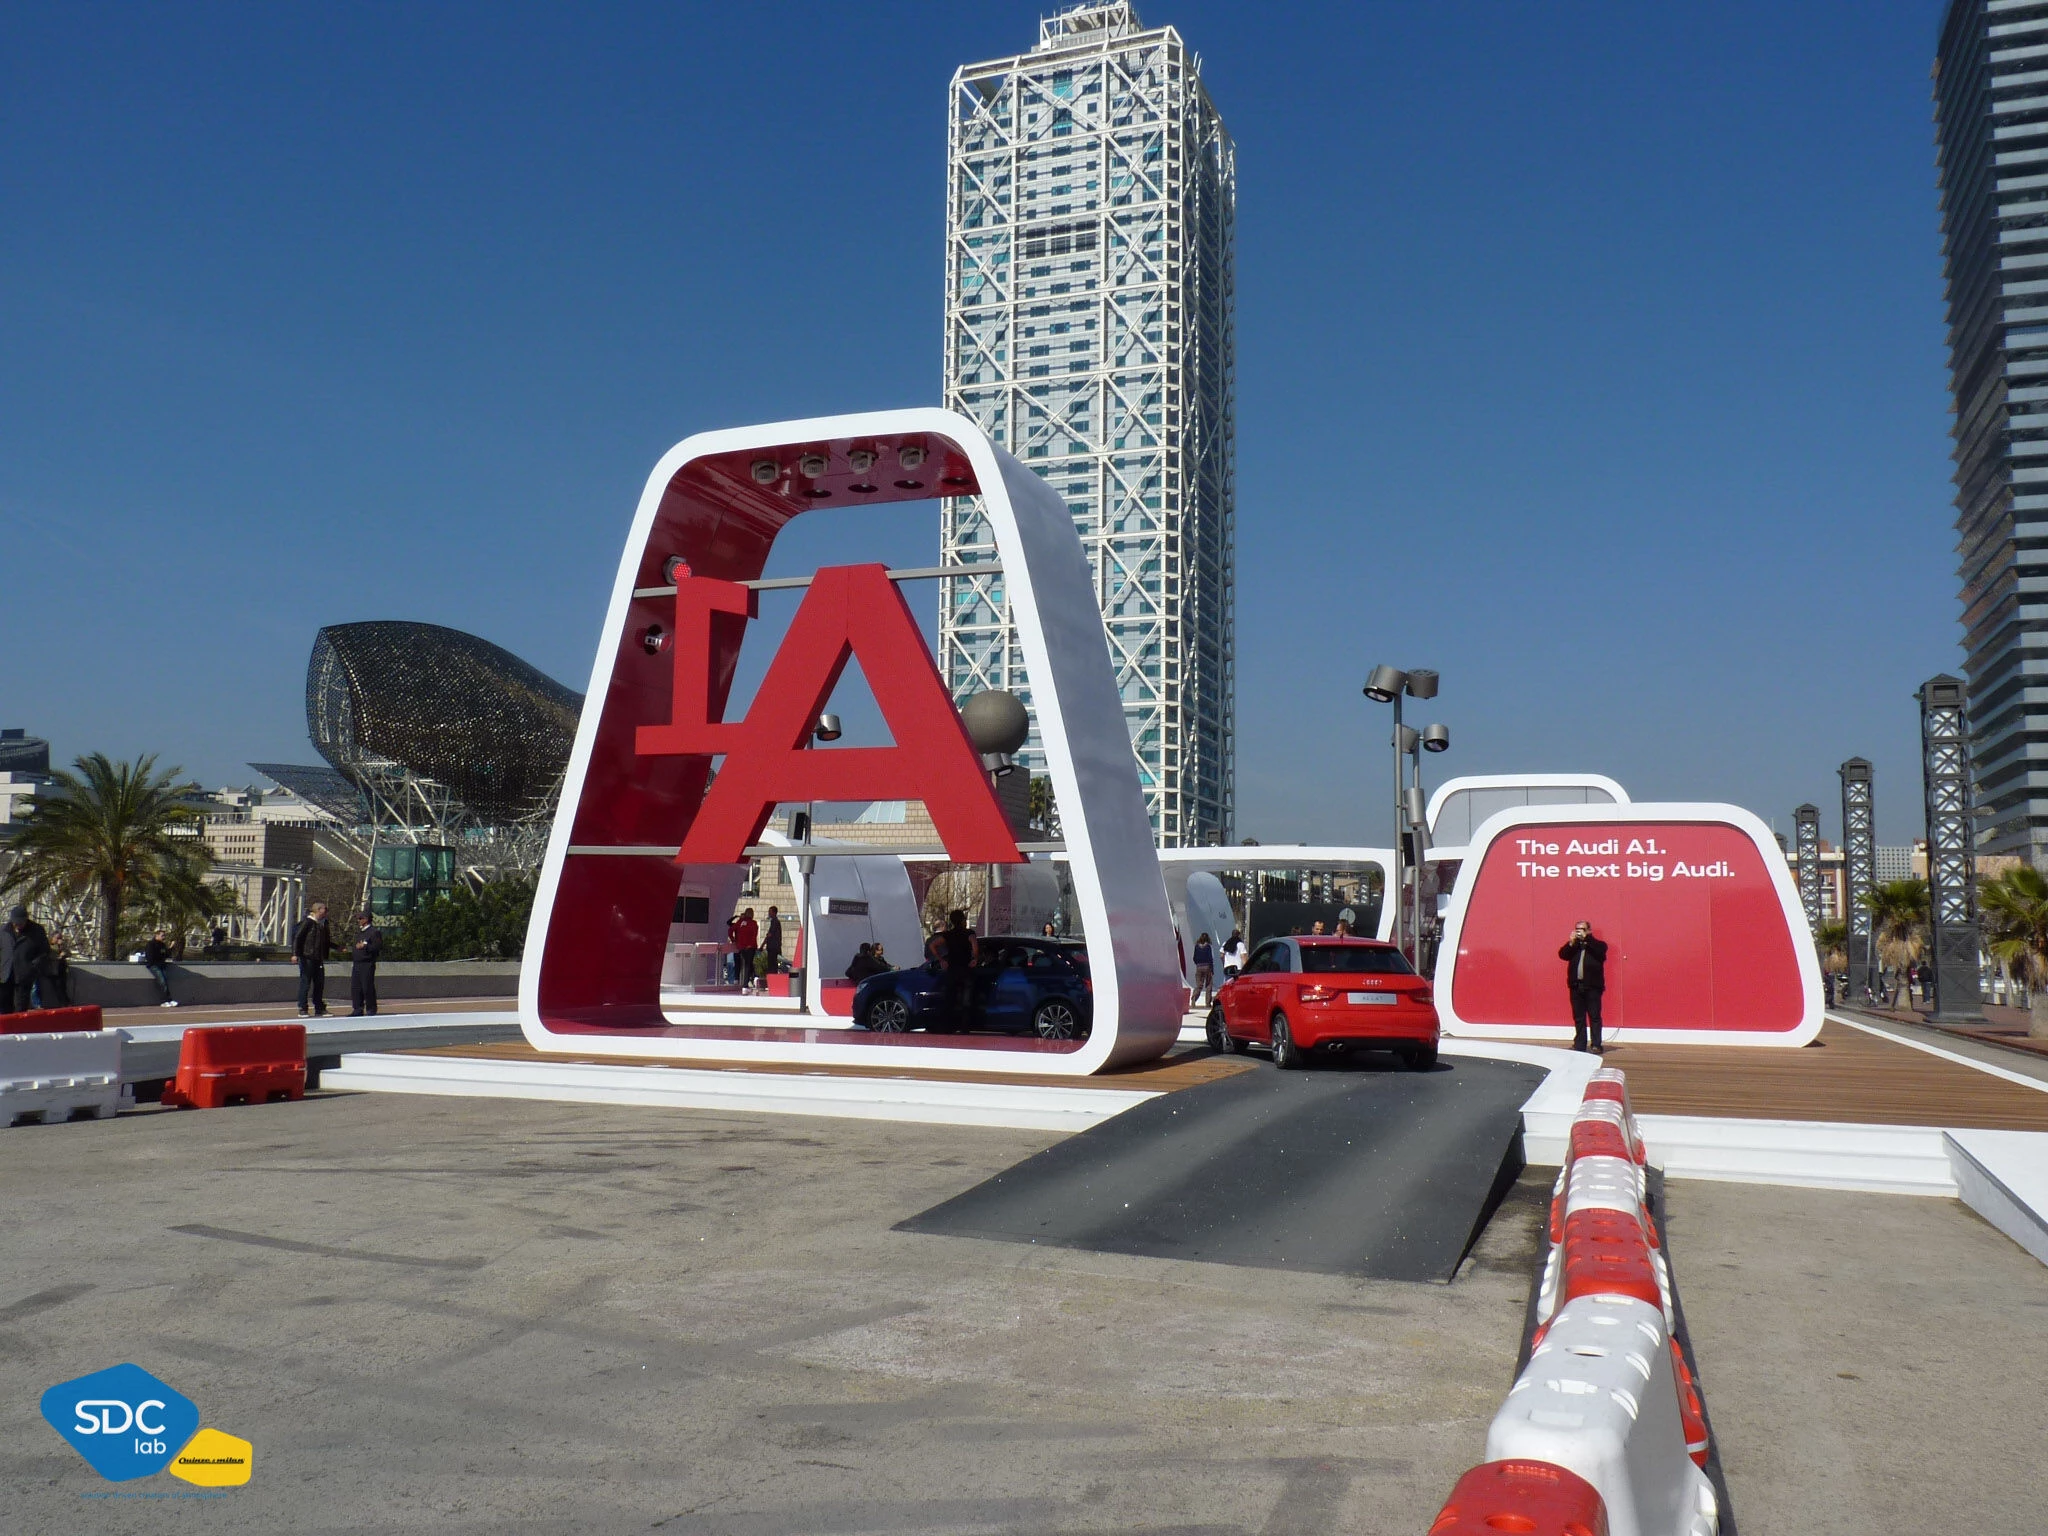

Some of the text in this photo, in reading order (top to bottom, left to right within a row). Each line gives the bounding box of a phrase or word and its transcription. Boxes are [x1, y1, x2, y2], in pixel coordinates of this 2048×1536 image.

[1516, 839, 1667, 855] The Audi A1.
[1516, 861, 1735, 881] The next big Audi.
